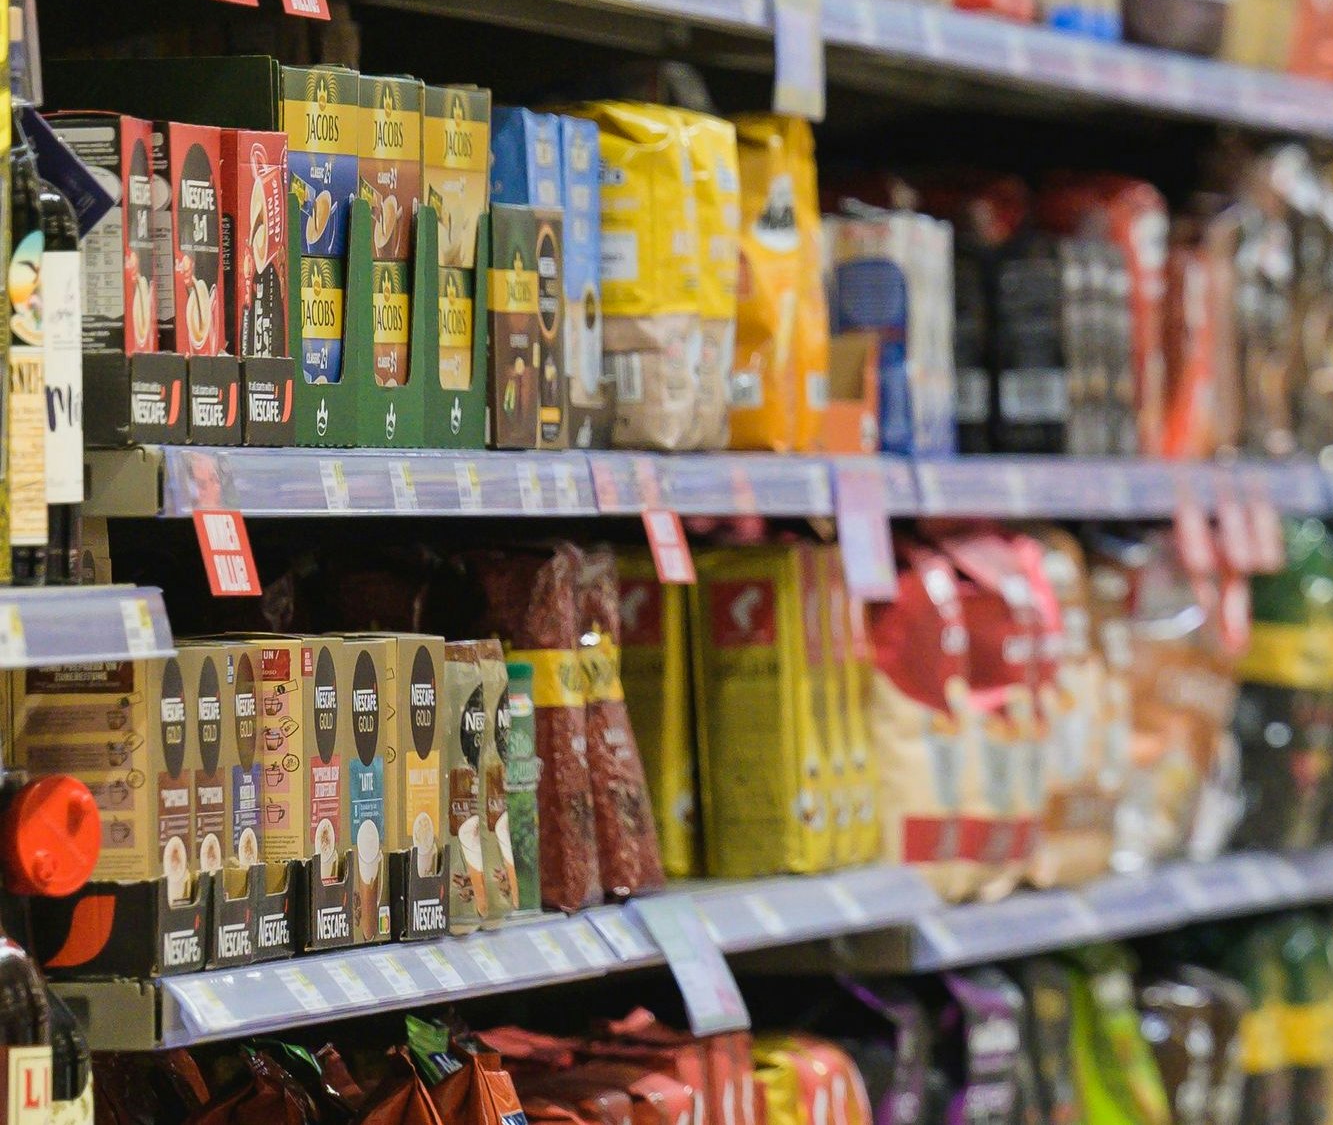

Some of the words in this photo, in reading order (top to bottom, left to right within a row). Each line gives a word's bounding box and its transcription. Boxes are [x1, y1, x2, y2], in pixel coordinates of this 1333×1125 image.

[305, 113, 340, 145] JACOBS
[373, 120, 404, 151] JACOBS
[443, 130, 473, 160] JACOBS
[301, 299, 335, 329] JACOBS
[372, 305, 403, 332] JACOBS
[240, 719, 253, 738] GOLD
[320, 712, 333, 730] GOLD
[358, 715, 374, 733] GOLD
[416, 709, 432, 727] GOLD
[202, 724, 217, 743] GOLD
